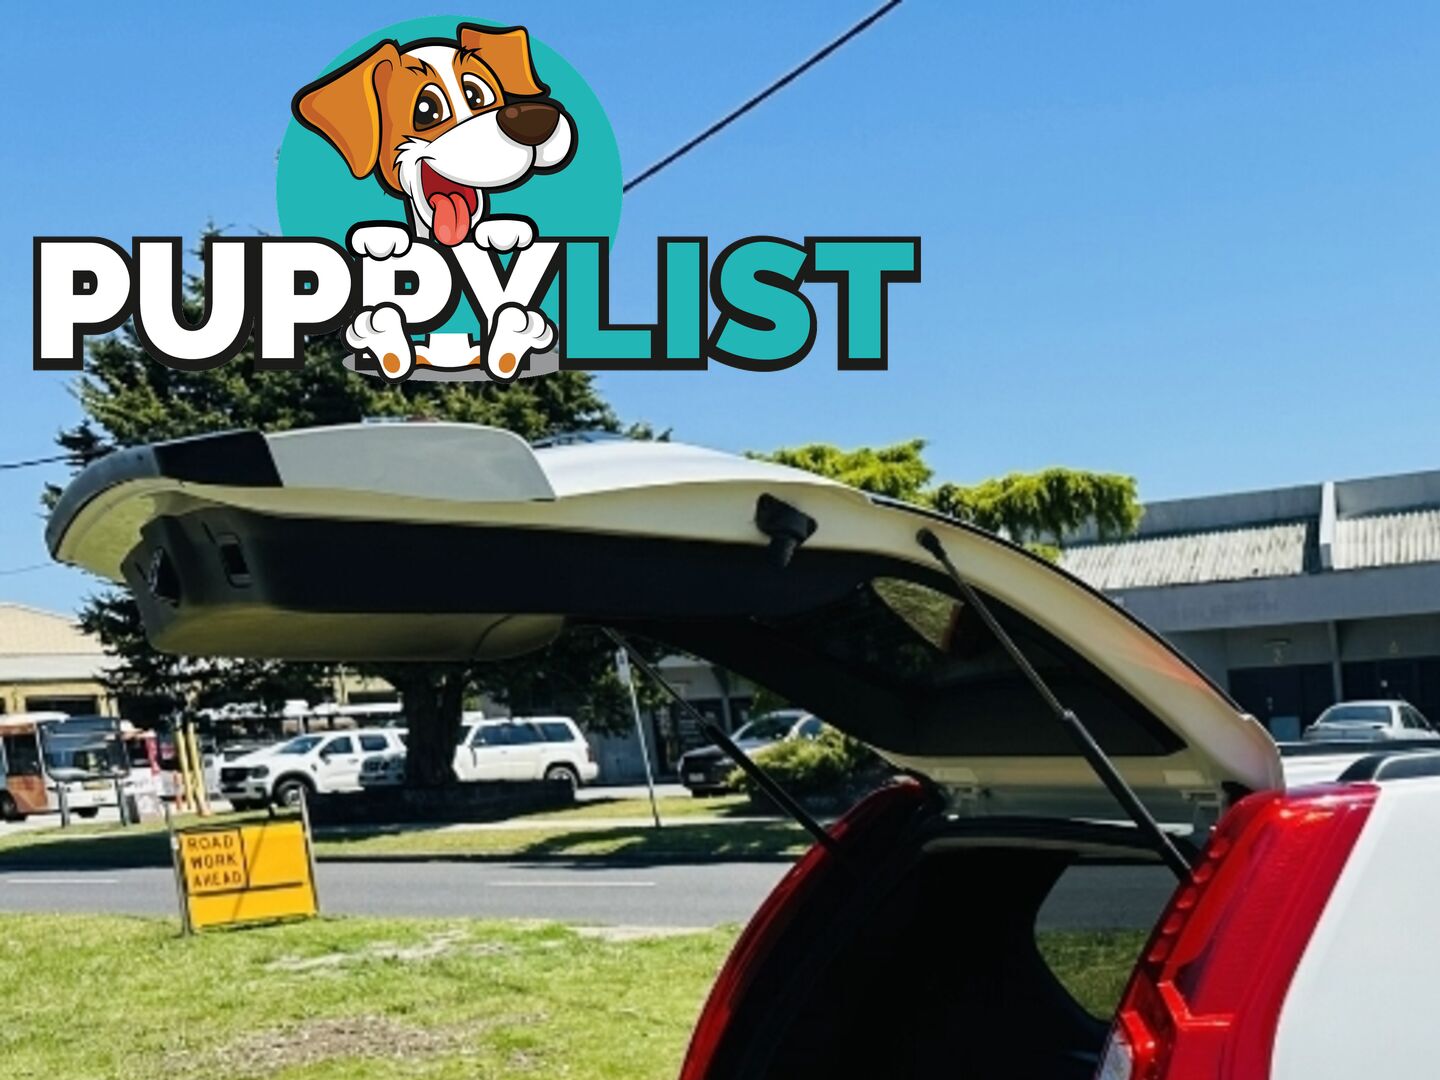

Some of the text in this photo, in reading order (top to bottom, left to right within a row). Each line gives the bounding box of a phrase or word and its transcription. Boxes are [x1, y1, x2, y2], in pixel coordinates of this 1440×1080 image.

[187, 835, 233, 849] ROAD
[191, 853, 238, 869] WORK
[193, 872, 241, 887] AHEAD
